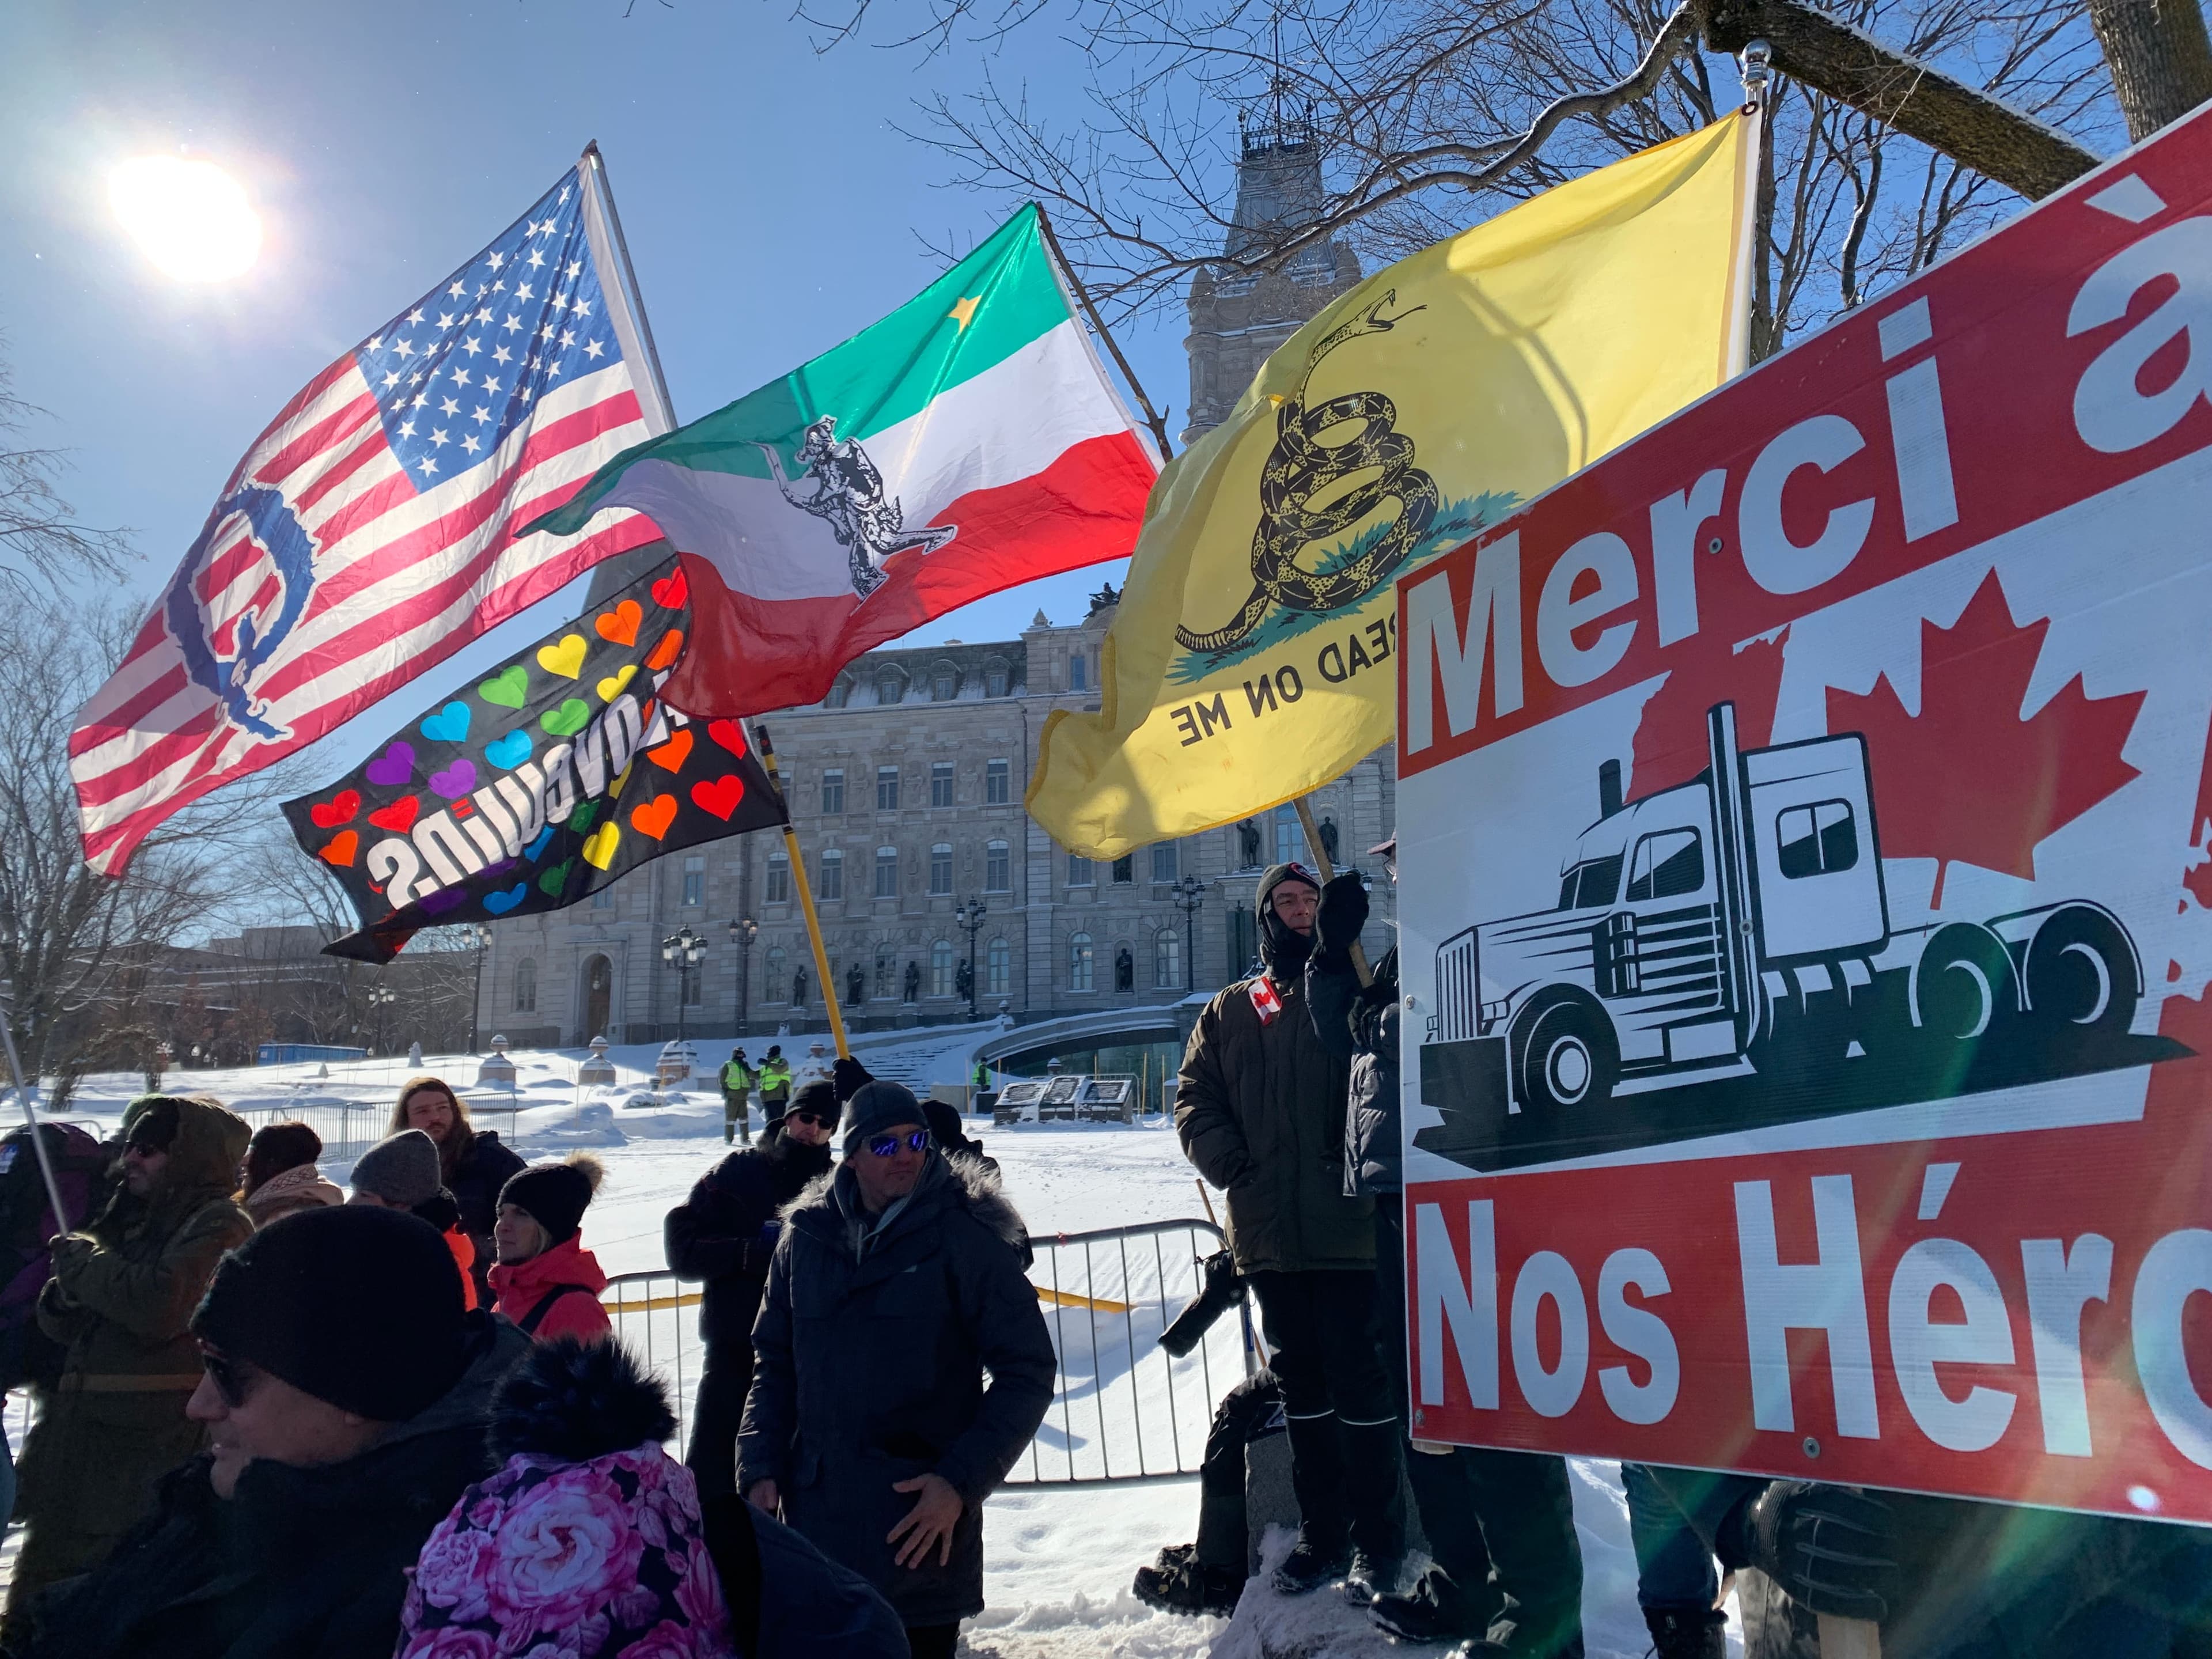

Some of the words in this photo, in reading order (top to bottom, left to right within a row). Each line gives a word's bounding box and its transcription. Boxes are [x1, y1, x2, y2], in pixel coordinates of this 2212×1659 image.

[1407, 297, 1959, 756] Merci
[2067, 172, 2212, 453] à
[1415, 1199, 1681, 1425] Nos
